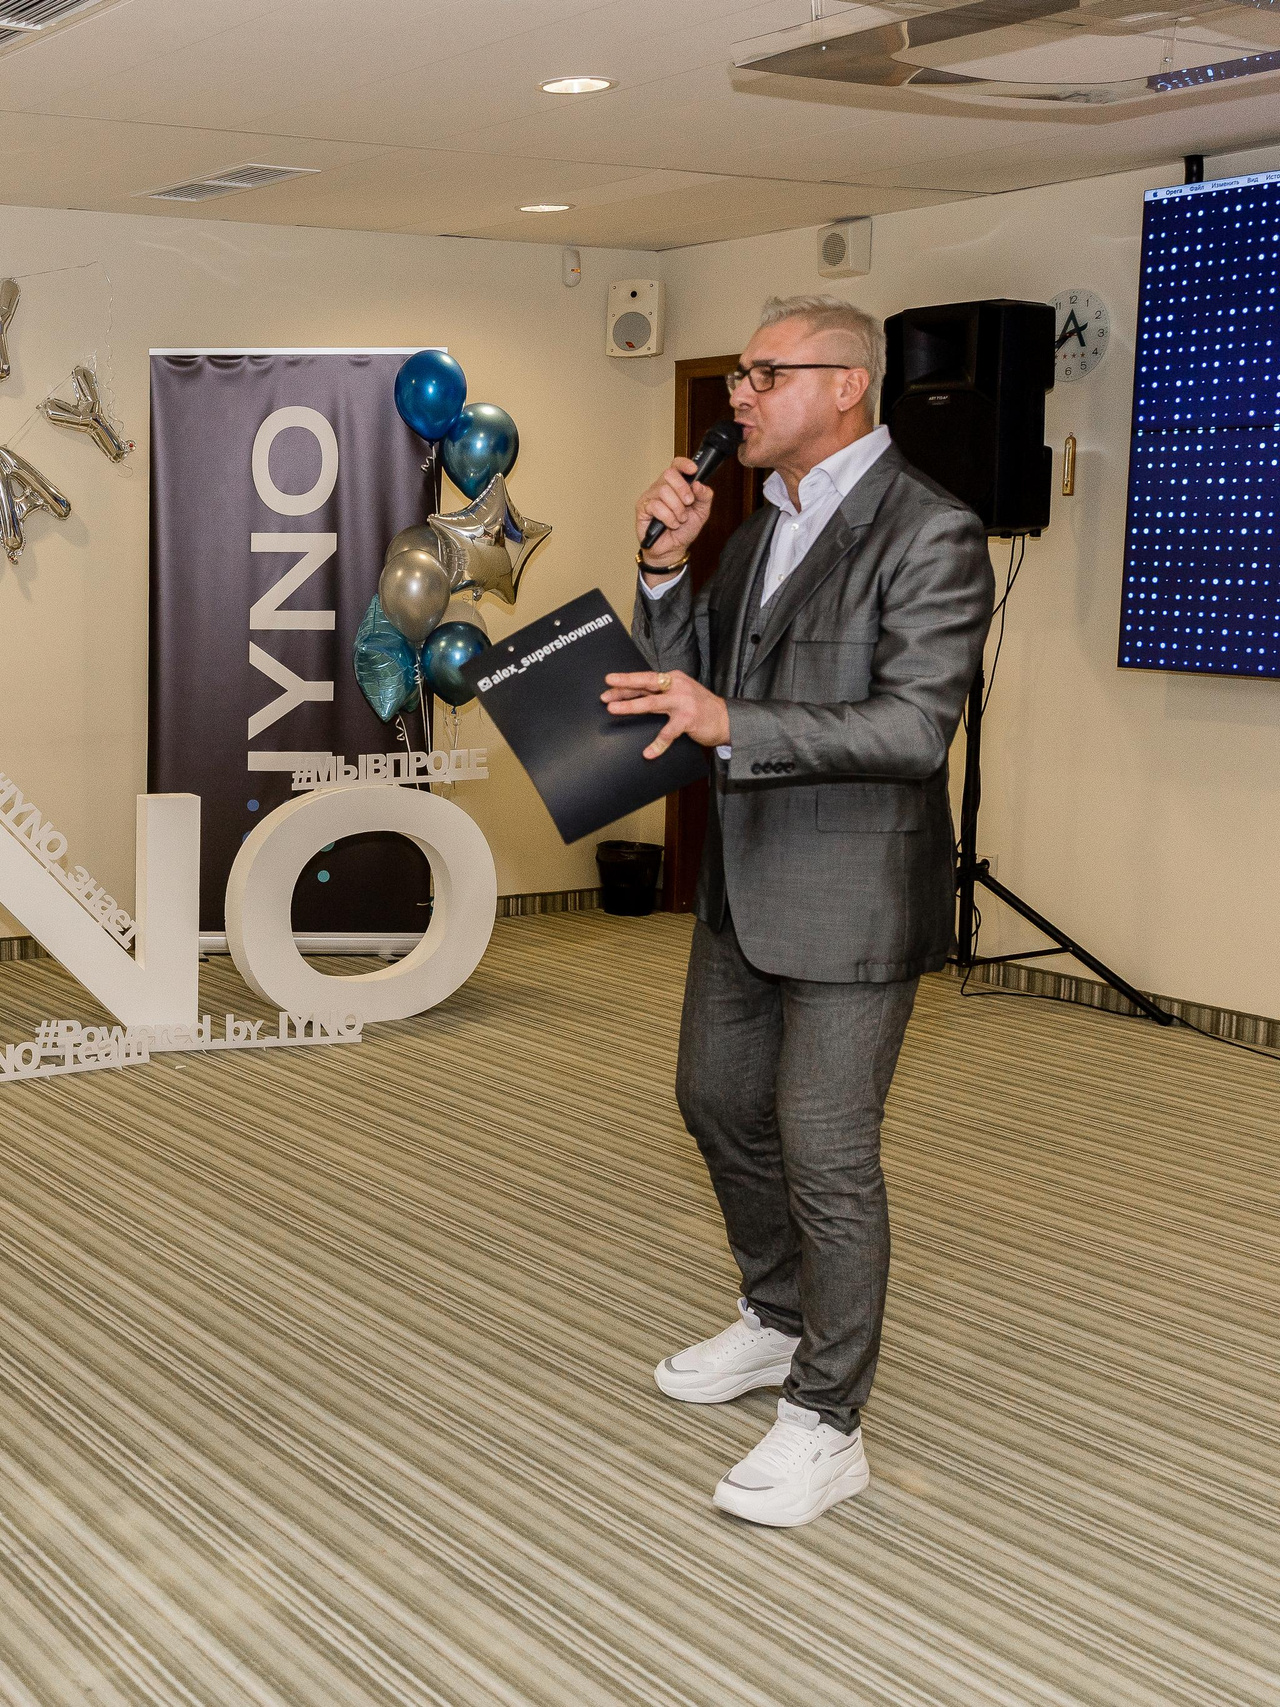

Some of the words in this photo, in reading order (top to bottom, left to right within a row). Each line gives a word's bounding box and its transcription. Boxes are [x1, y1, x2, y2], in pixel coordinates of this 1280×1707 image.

[1069, 295, 1078, 305] 12
[1094, 310, 1102, 320] 2
[1097, 328, 1105, 338] 3
[1091, 347, 1099, 356] 4
[1064, 366, 1072, 376] 6
[1080, 361, 1088, 371] 5
[248, 406, 339, 772] IYNO
[490, 613, 614, 685] alex_supershowman
